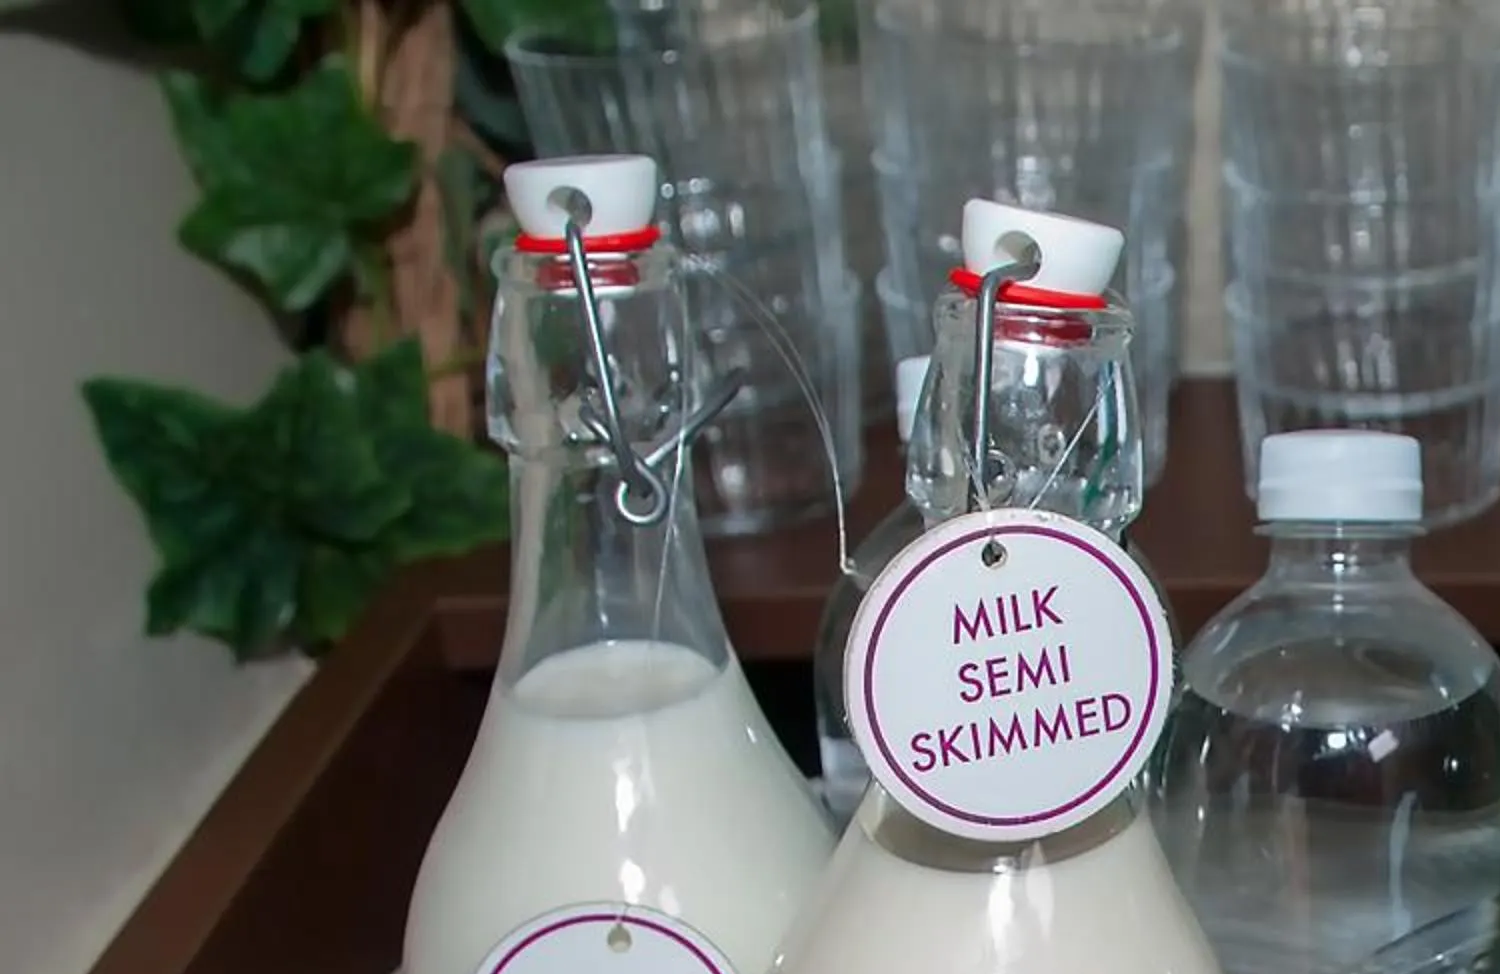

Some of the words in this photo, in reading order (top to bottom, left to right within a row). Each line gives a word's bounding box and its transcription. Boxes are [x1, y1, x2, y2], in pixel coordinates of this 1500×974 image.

[953, 586, 1064, 645] MILK
[958, 645, 1071, 703] SEMI
[911, 692, 1132, 772] SKIMMED
